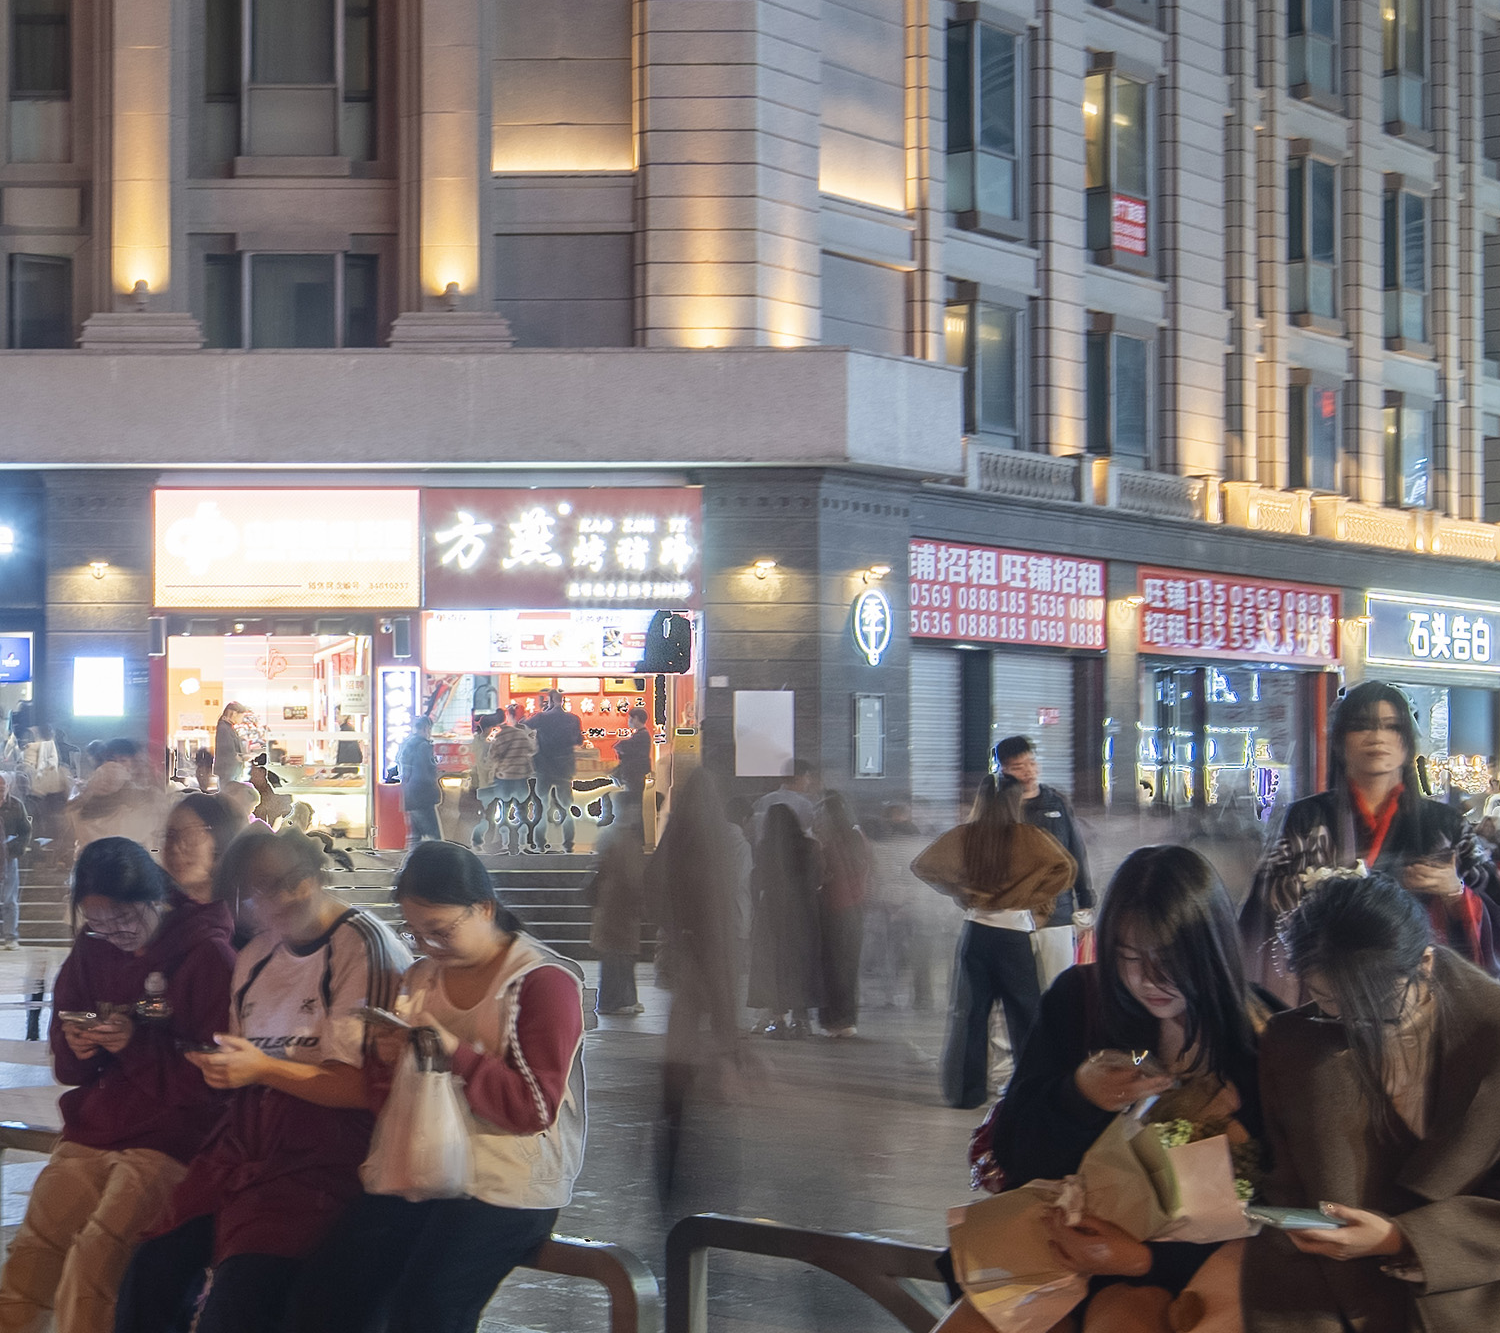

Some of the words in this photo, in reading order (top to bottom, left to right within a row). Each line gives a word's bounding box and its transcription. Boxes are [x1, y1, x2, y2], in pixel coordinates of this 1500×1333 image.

[910, 583, 951, 609] 0569
[958, 587, 997, 612] 0888
[1001, 591, 1026, 614] 185
[1031, 594, 1065, 618] 5636
[1188, 580, 1227, 604] 185
[1229, 585, 1282, 611] 0569
[1284, 590, 1332, 616] 0888
[1188, 601, 1227, 625] 185
[910, 609, 951, 635] 5636
[958, 613, 997, 638] 0888
[1001, 617, 1026, 640] 185
[1031, 619, 1065, 643] 0569
[1069, 622, 1103, 646] 0888
[1408, 612, 1491, 663] 石头告白
